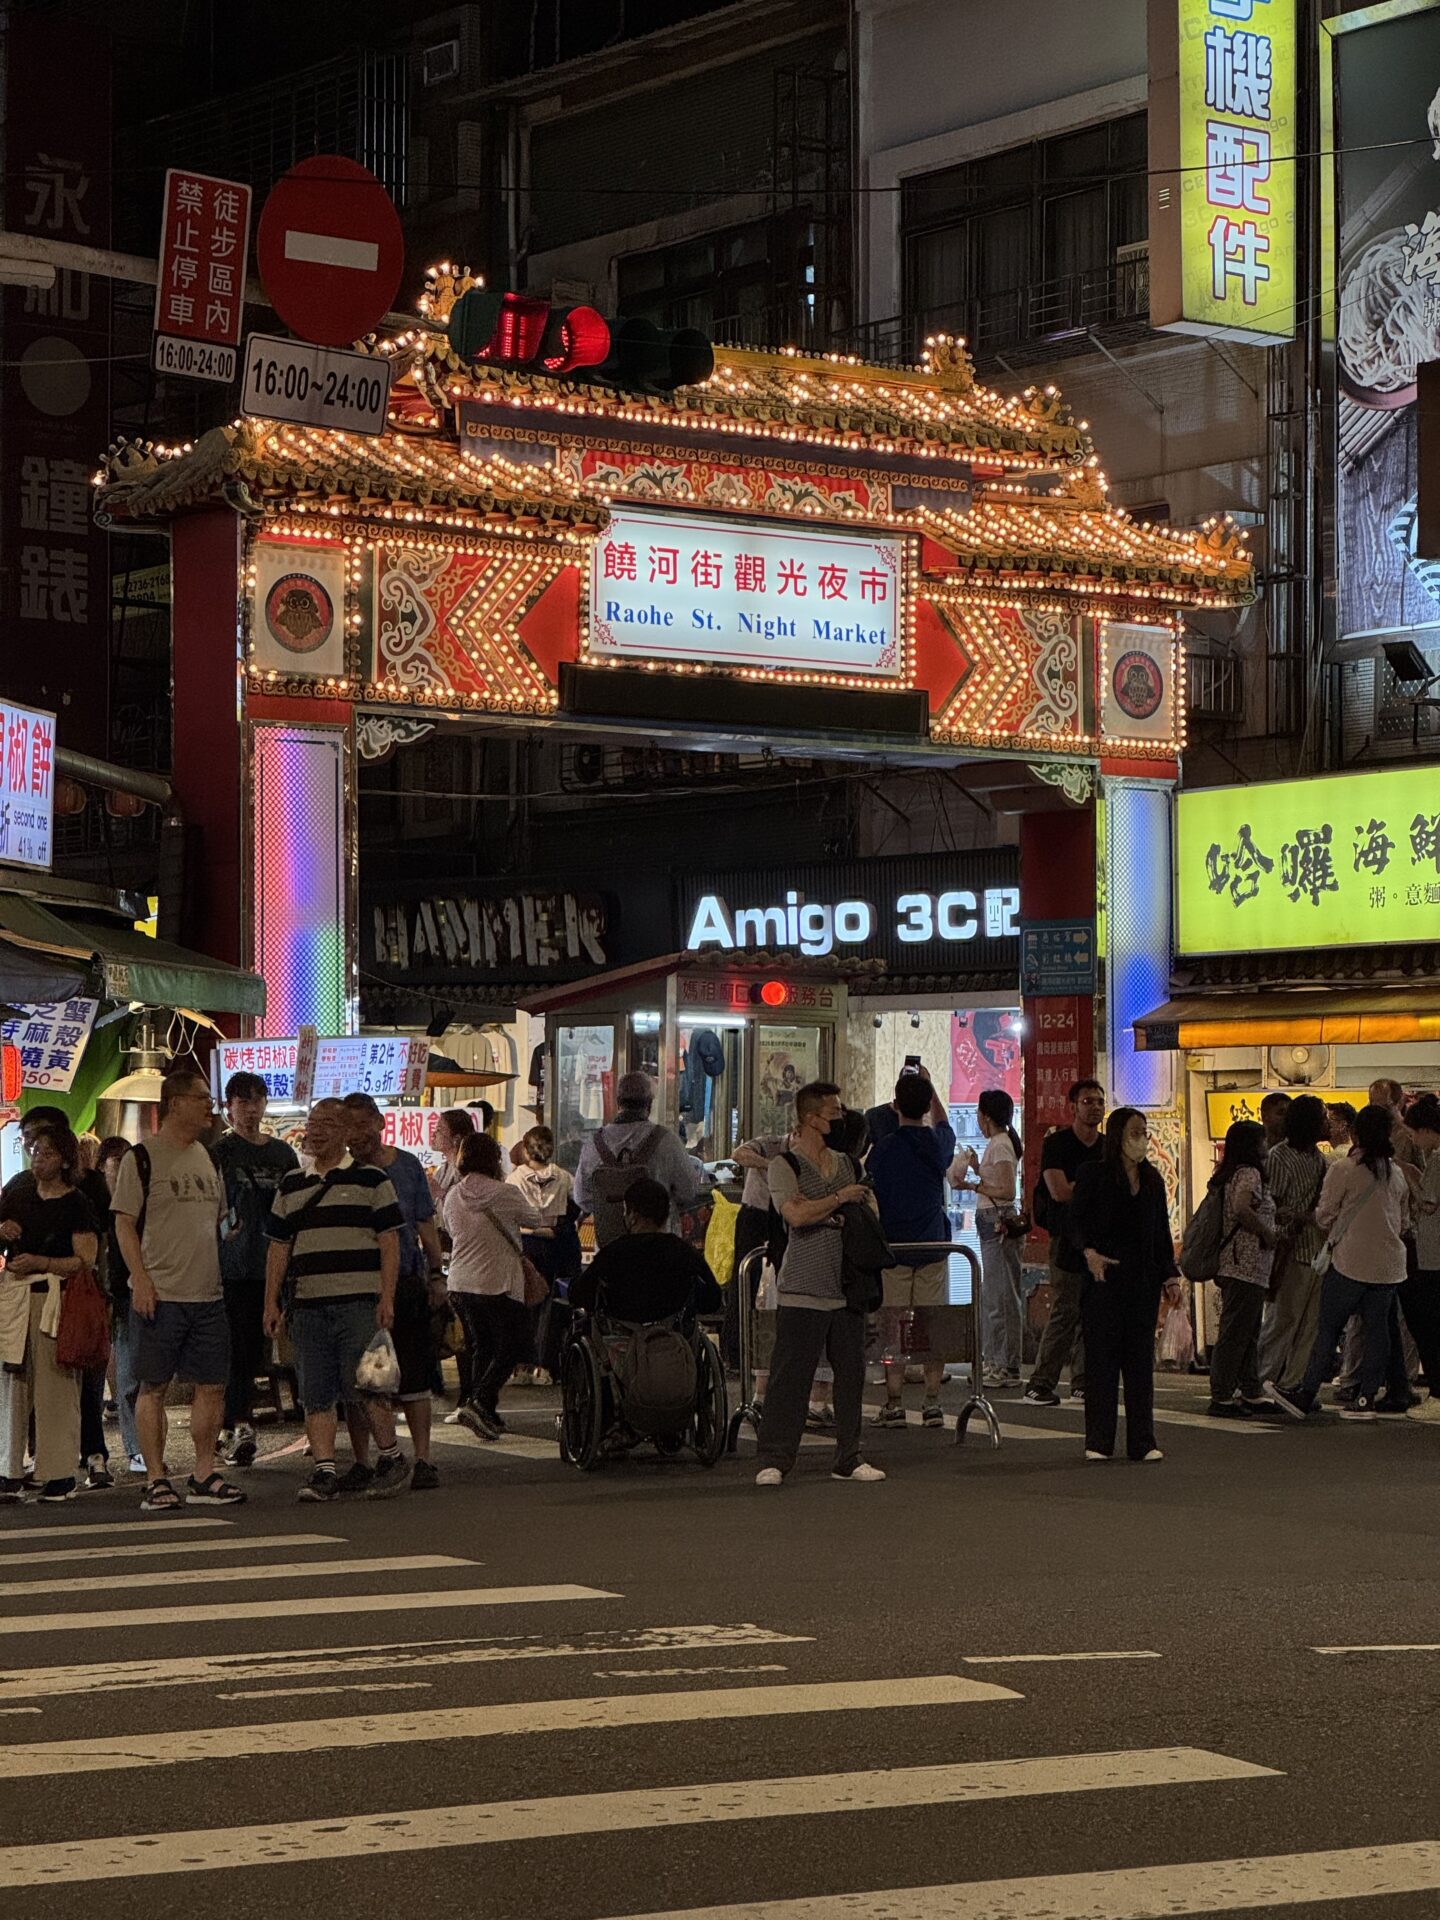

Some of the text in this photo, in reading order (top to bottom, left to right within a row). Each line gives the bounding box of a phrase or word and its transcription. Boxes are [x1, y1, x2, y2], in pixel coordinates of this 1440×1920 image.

[168, 180, 204, 326] 禁止停車
[204, 188, 240, 334] 徒步區內
[159, 341, 233, 379] 16:00-24:00
[253, 358, 381, 414] 16:00~24:00
[20, 455, 89, 624] 鐘錶
[603, 540, 889, 604] 饒河街觀光夜市
[605, 601, 887, 645] Raohe St. Night Market
[0, 712, 51, 799] 椒餅
[14, 809, 48, 832] second one
[38, 842, 47, 861] off
[687, 891, 870, 956] Amigo
[45, 1000, 92, 1072] 蟹殼黃
